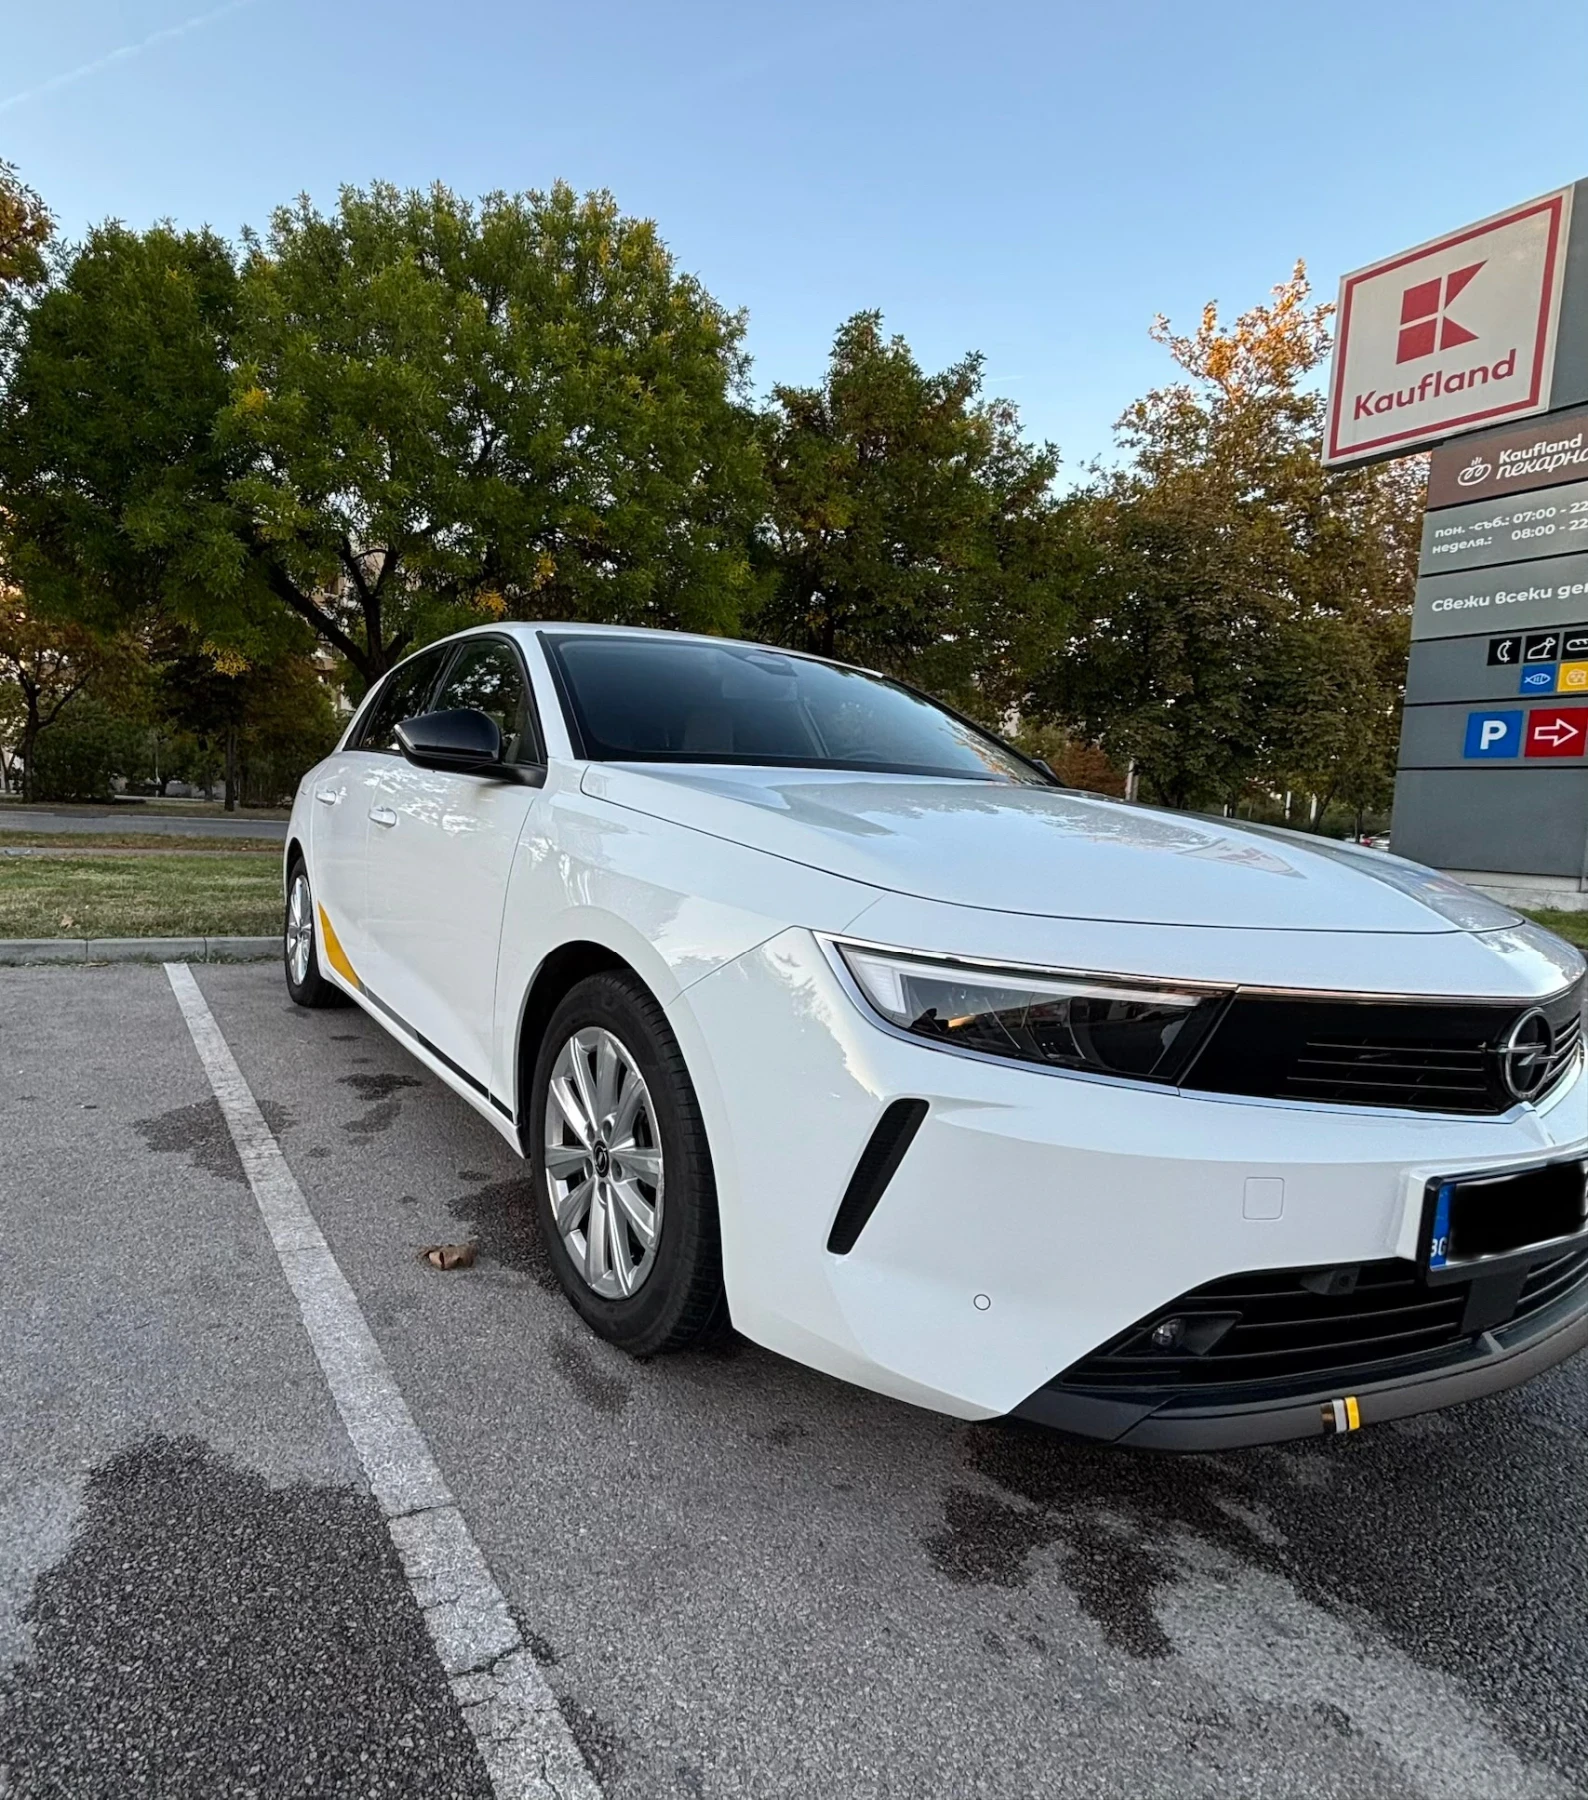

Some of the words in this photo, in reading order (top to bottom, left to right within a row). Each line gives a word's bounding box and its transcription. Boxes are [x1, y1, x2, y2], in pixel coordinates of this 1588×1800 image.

[1353, 348, 1517, 421] Kaufland
[1499, 433, 1583, 464] Kaufland
[1435, 526, 1466, 538] пон.
[1513, 507, 1556, 523] 07:00
[1511, 524, 1555, 540] 08:00
[1431, 595, 1490, 612] Свежи
[1495, 587, 1552, 605] всеки
[1480, 720, 1508, 750] P
